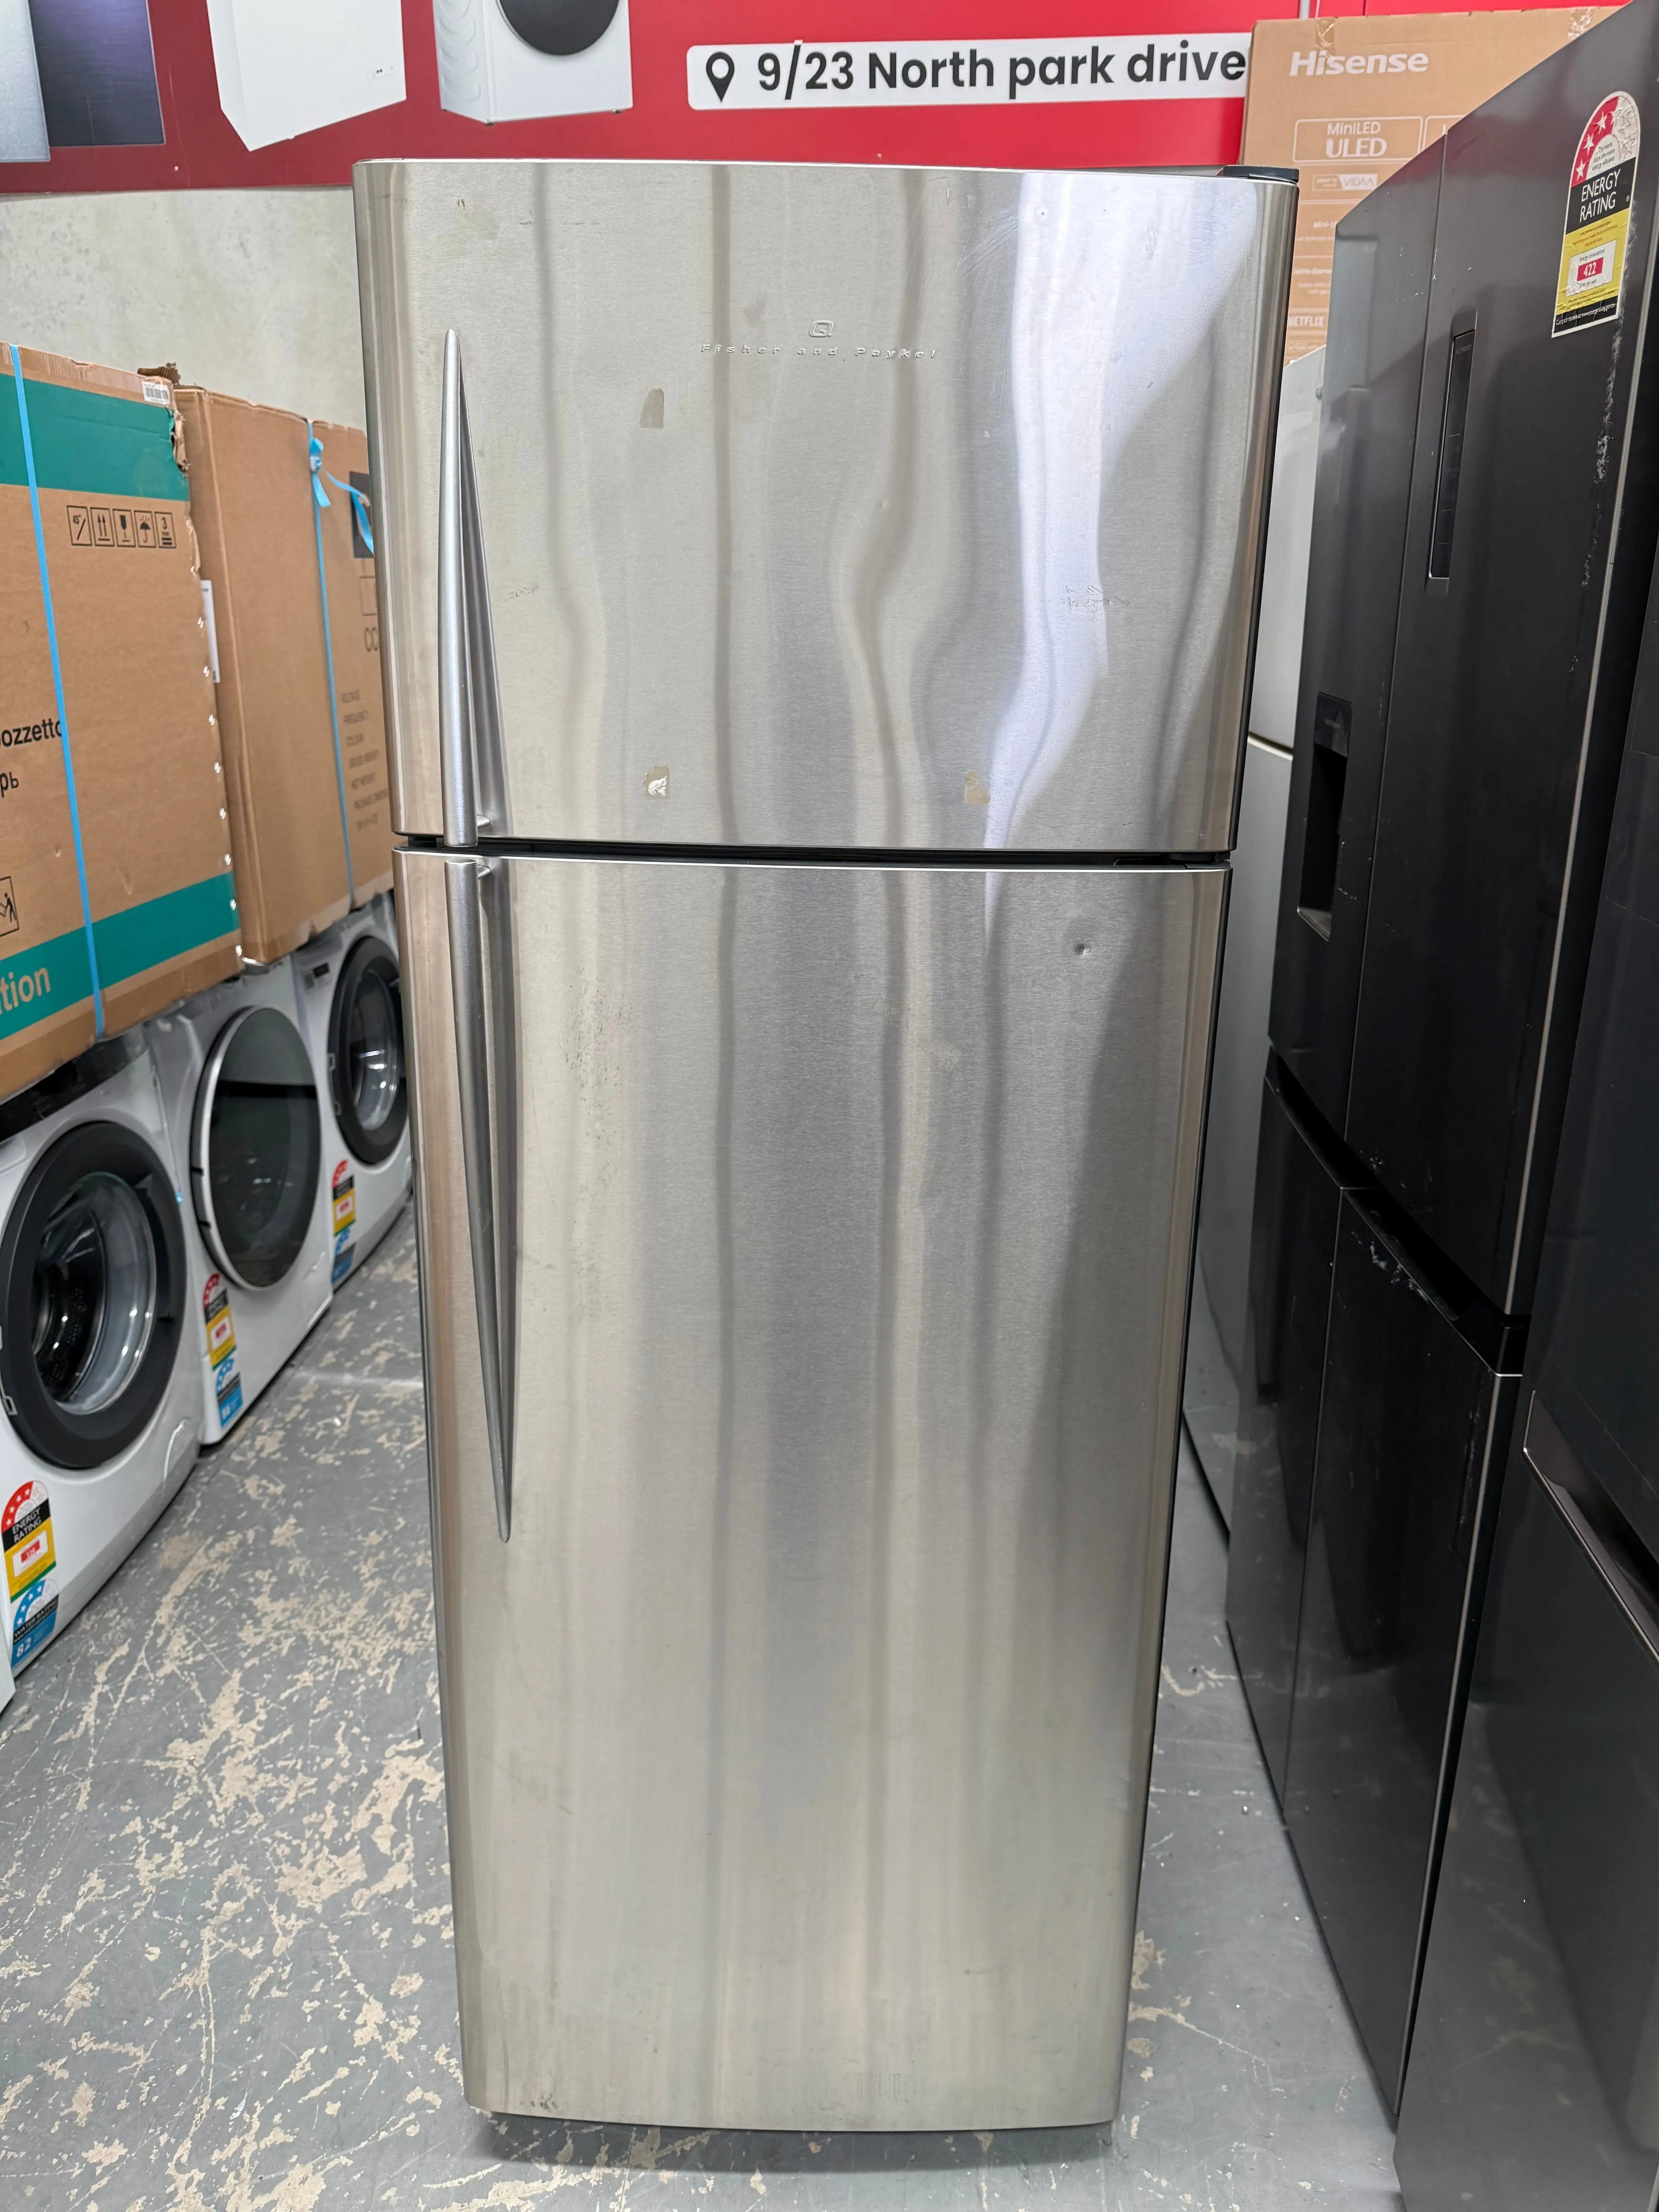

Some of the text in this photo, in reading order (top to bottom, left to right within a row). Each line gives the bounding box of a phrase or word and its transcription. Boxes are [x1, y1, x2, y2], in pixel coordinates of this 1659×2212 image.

[758, 40, 1245, 100] 9/23 North park drive
[1290, 51, 1429, 76] Hisense
[1326, 137, 1387, 158] ULED
[1581, 168, 1621, 202] ENERGY
[1580, 191, 1616, 222] RATING
[1583, 261, 1596, 277] 422
[701, 344, 937, 359] Fisher and Paykel
[12, 1507, 40, 1535] ENERGY
[14, 1516, 41, 1543] RATING
